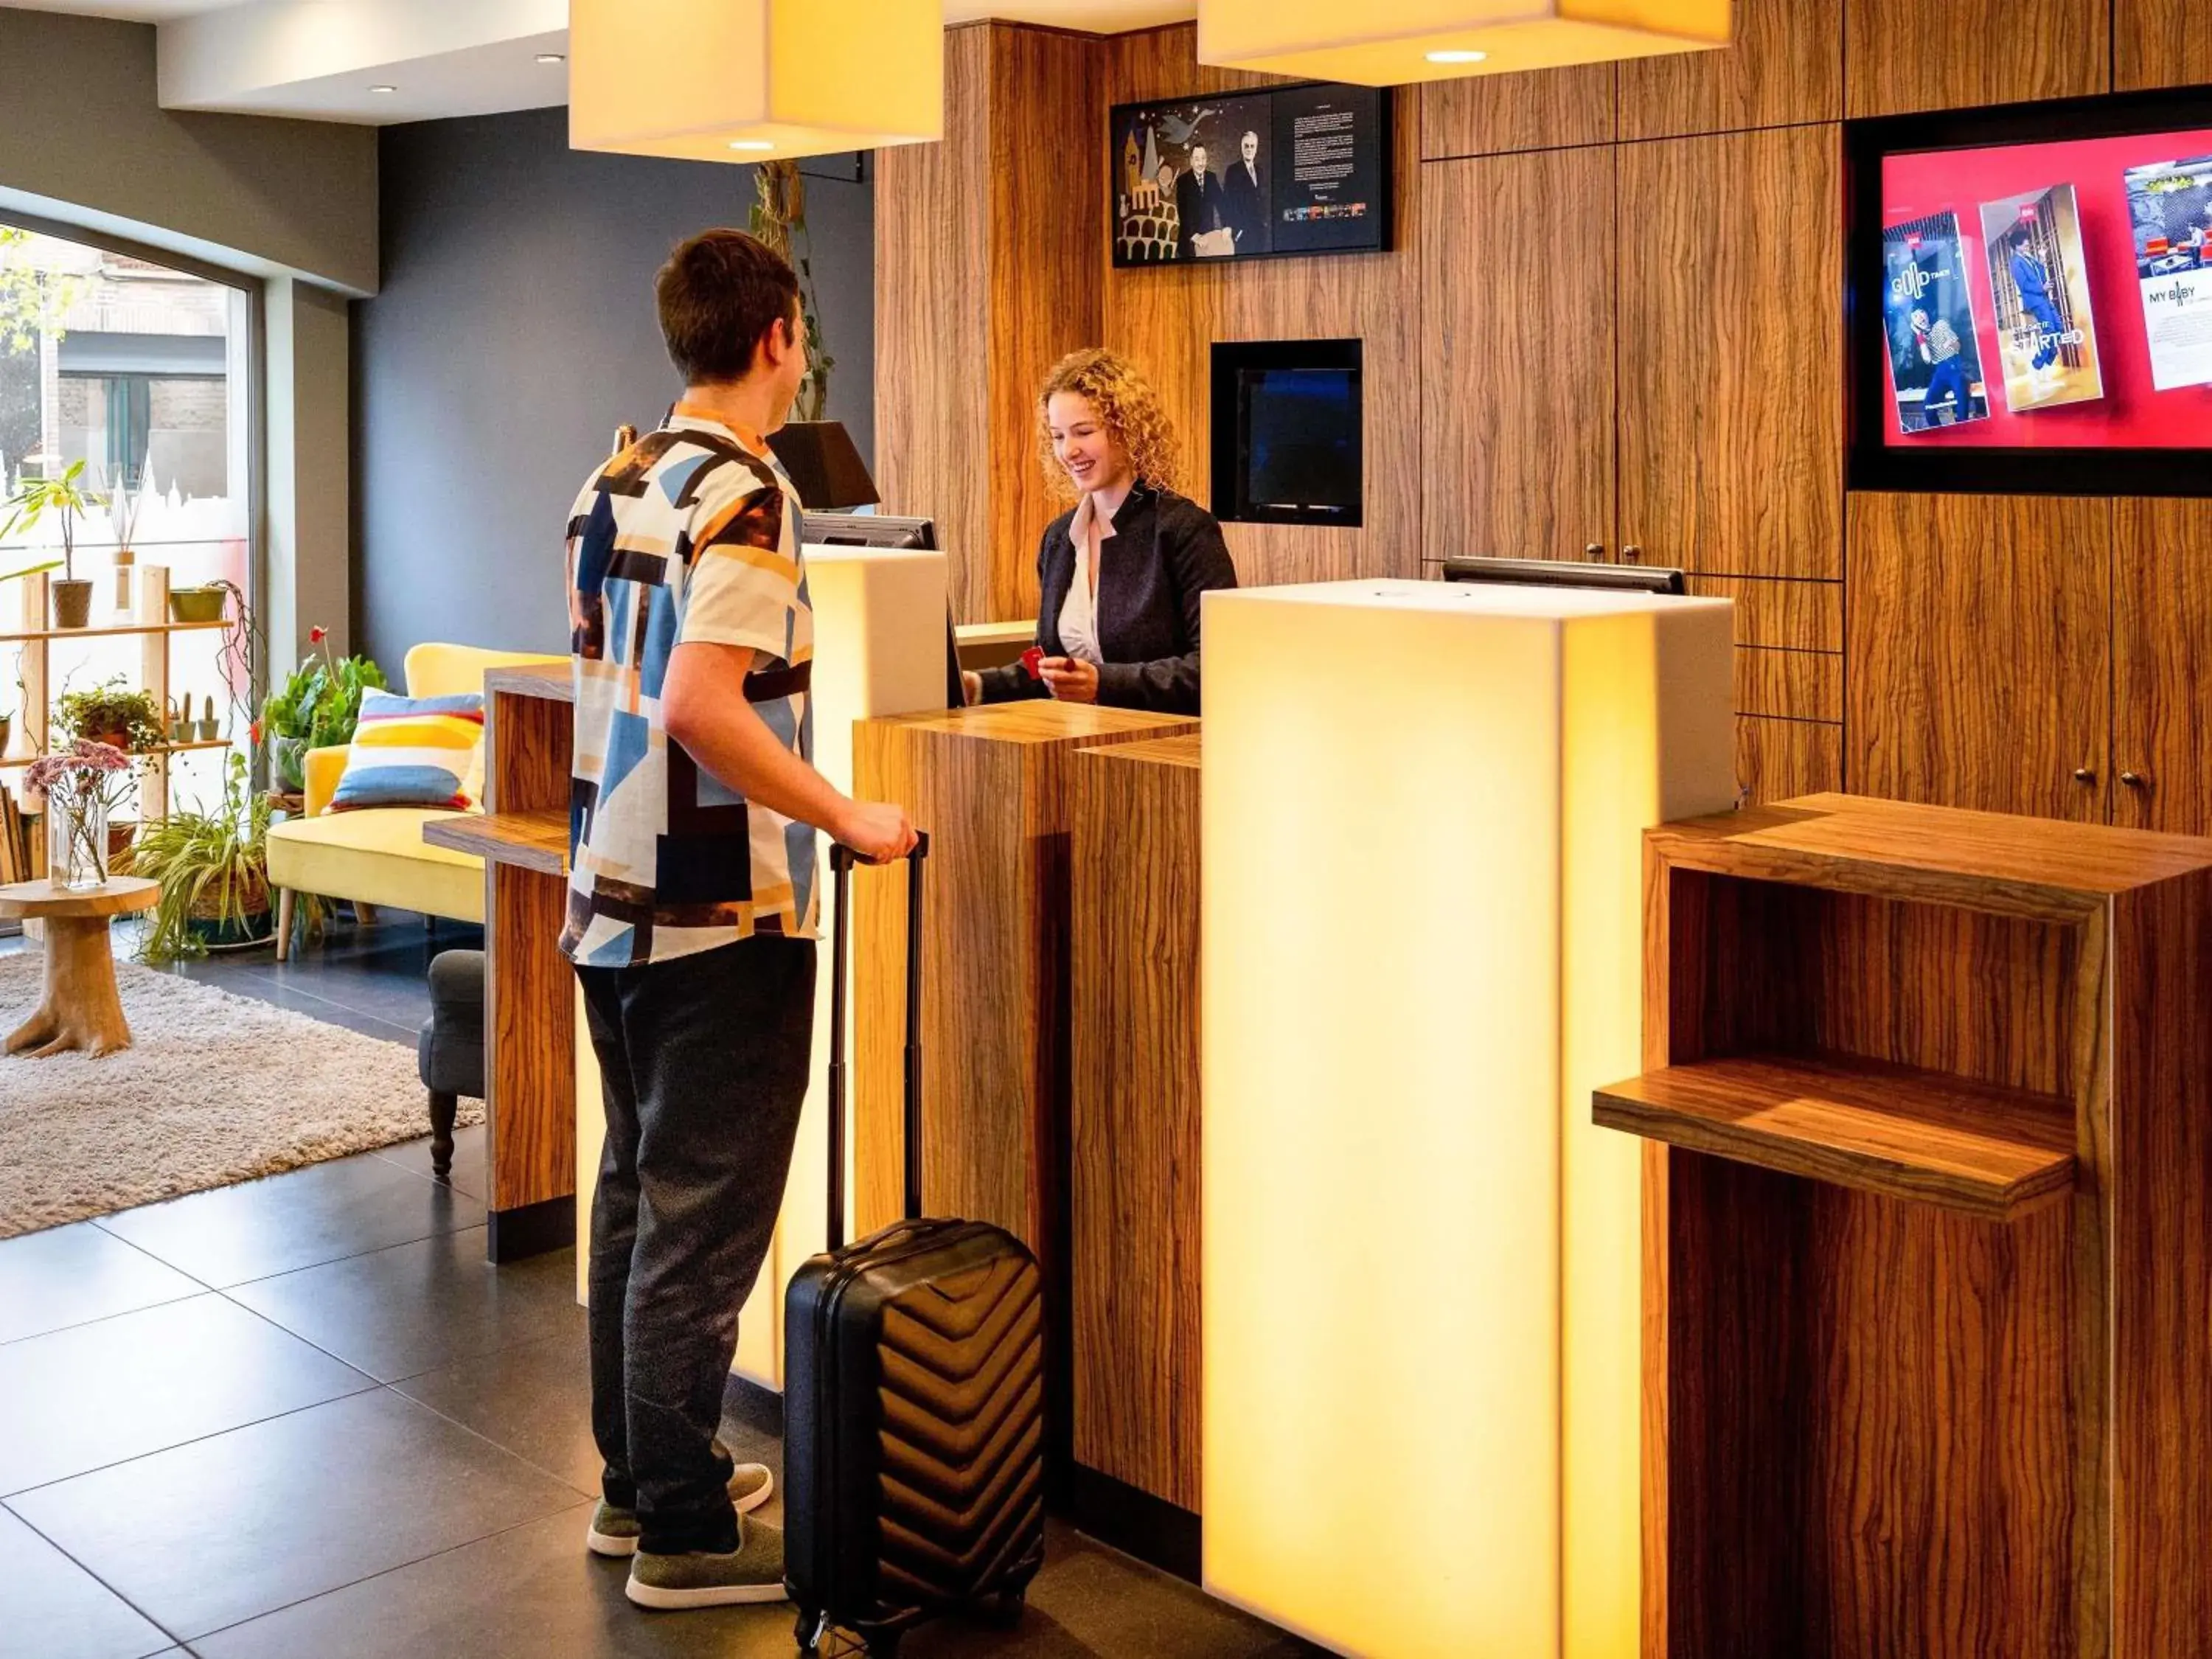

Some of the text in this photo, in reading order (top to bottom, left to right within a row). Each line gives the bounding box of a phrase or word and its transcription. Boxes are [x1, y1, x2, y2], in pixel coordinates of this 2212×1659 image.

[1891, 262, 1930, 299] GOOD
[2149, 291, 2166, 303] MY
[2168, 281, 2194, 307] BABY
[2011, 328, 2084, 357] STARTED
